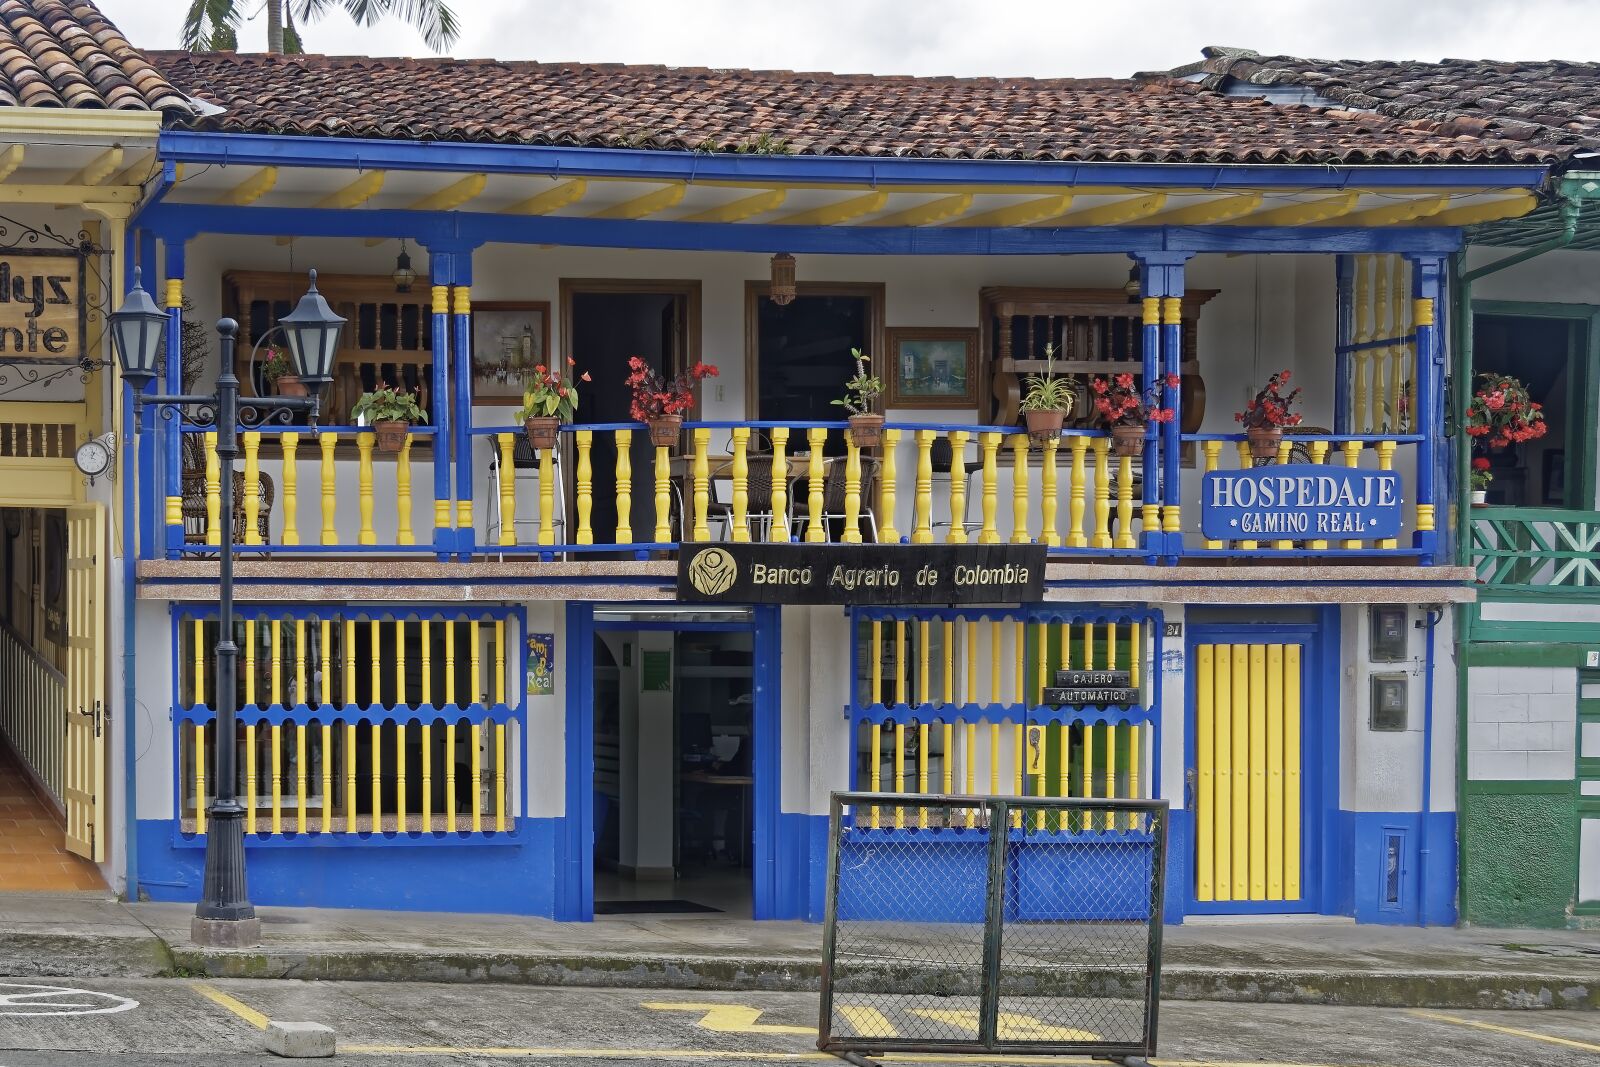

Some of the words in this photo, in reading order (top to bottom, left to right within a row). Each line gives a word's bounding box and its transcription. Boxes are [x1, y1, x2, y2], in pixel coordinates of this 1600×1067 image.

[1210, 476, 1396, 508] HOSPEDAJE
[1241, 512, 1308, 534] CAMINO
[1317, 512, 1365, 533] REAL
[752, 563, 812, 586] Banco
[830, 563, 899, 590] Agrario
[915, 564, 938, 587] de
[954, 564, 1029, 586] Colombia
[1073, 674, 1113, 684] CAJERO
[1059, 690, 1126, 701] AUTOMATICO
